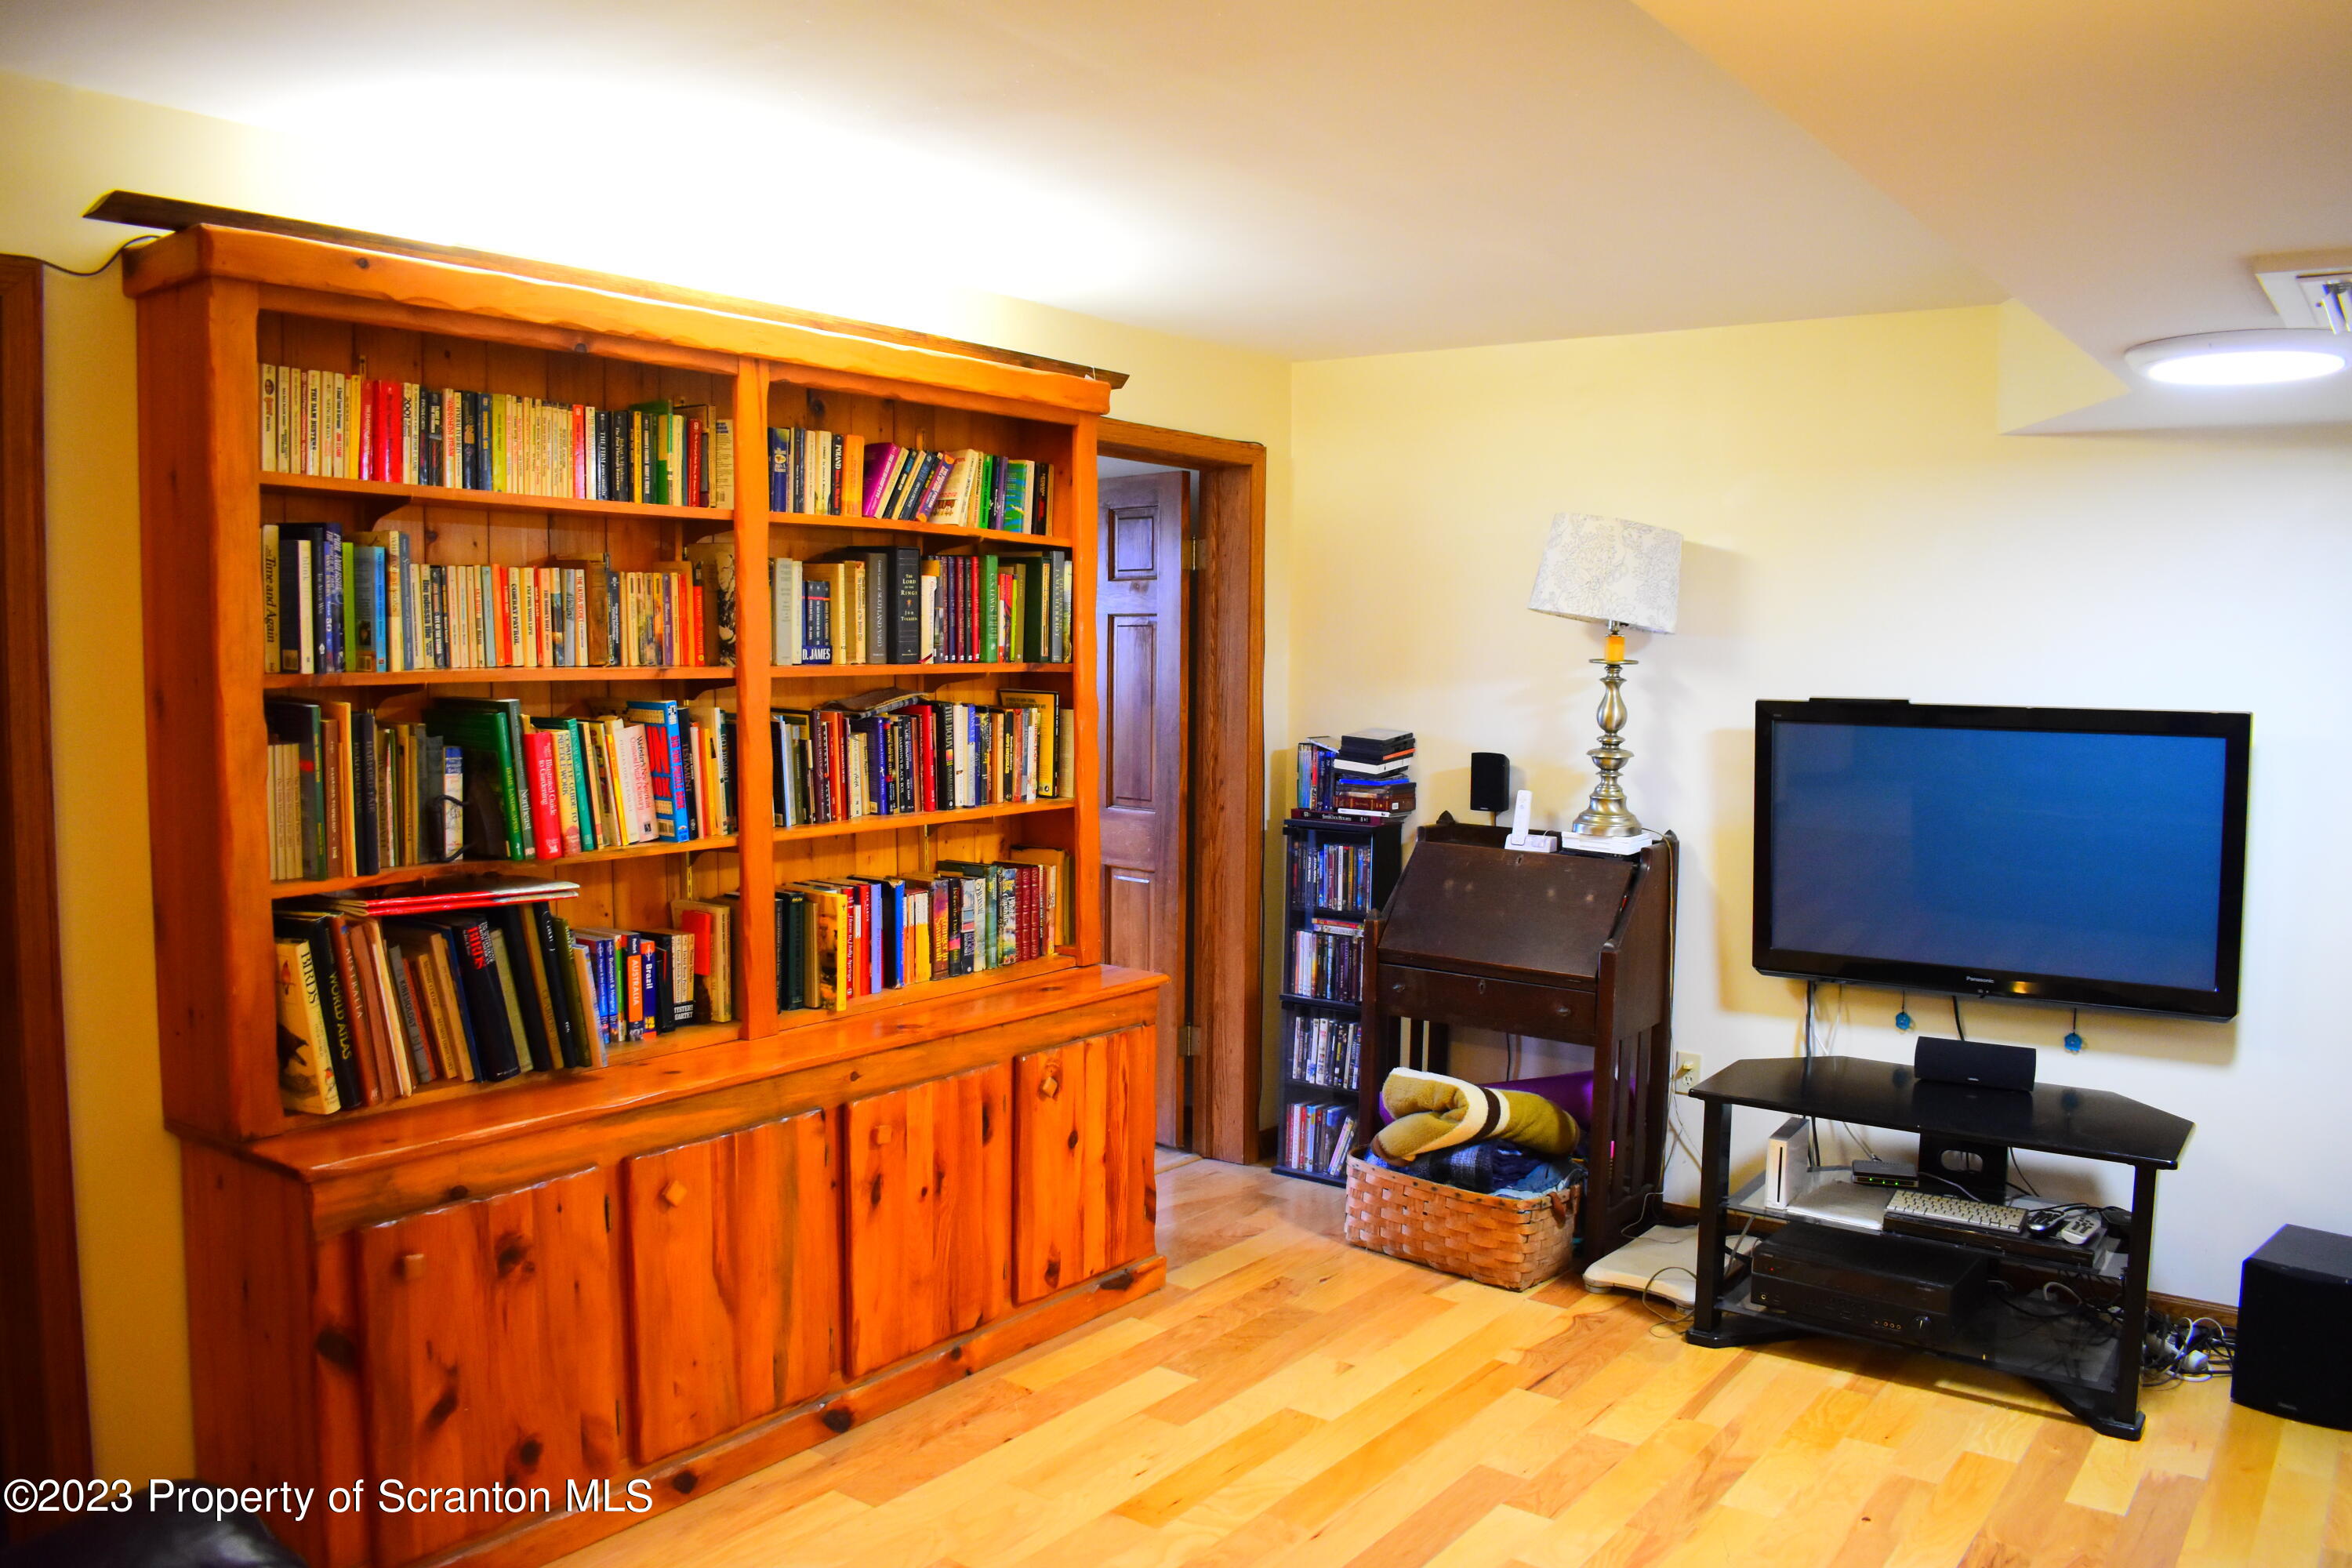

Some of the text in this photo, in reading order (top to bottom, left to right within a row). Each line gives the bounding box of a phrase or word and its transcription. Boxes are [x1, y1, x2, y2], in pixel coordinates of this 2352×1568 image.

[403, 397, 412, 418] 2001
[265, 557, 276, 583] Time
[266, 585, 276, 606] and
[264, 609, 277, 642] Again
[326, 618, 332, 632] 50
[810, 648, 830, 659] JAMES
[557, 735, 568, 796] NEEDLEWORK
[636, 735, 647, 768] Webster's
[643, 782, 652, 808] American
[673, 751, 681, 763] FUN
[682, 743, 691, 791] TESTAMENT
[539, 768, 548, 805] Gardening
[546, 759, 556, 793] Illustrated
[564, 733, 575, 780] COMPLETE
[572, 808, 578, 822] TO
[673, 765, 684, 789] PUZZLE
[521, 789, 532, 829] Northeast
[676, 791, 685, 809] BOOK
[466, 926, 486, 969] BIRDS
[301, 952, 319, 1003] BIRDS
[346, 948, 364, 1018] AUSTRALIA
[1965, 975, 1994, 984] Panasonic
[328, 971, 352, 1058] WORLD ATLAS
[401, 978, 417, 1028] KINESIOLOGY
